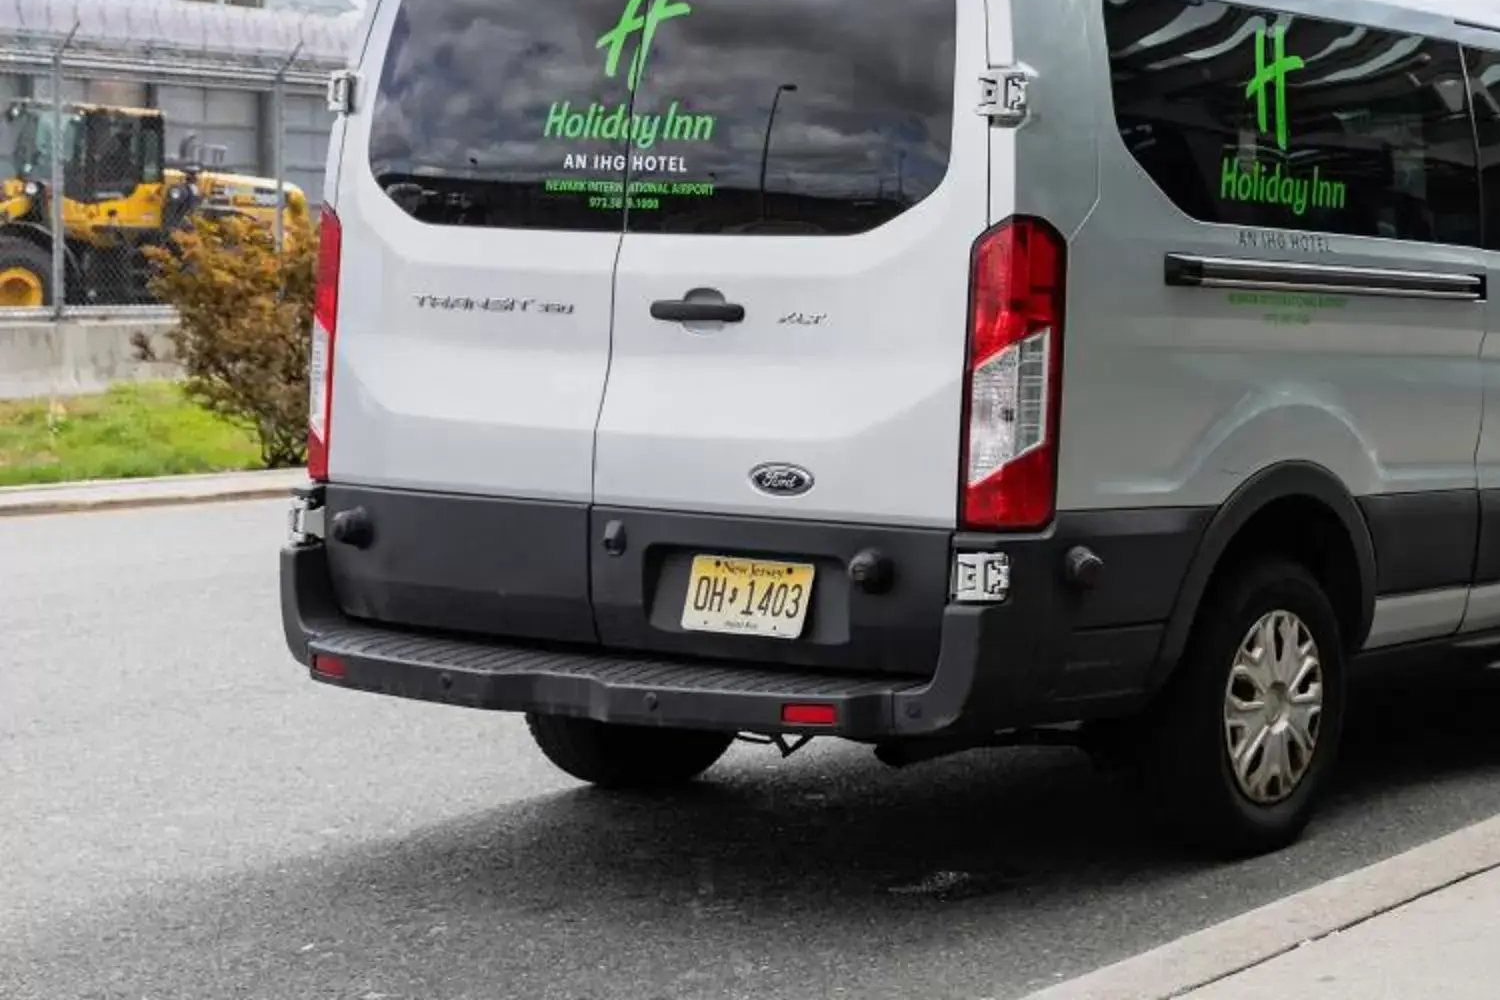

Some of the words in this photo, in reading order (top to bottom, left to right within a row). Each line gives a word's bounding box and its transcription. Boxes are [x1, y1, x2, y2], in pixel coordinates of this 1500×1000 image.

[543, 100, 661, 149] Holiday
[663, 101, 716, 141] Inn
[563, 153, 588, 170] AN
[593, 154, 626, 171] IHG
[632, 155, 688, 173] HOTEL
[1221, 156, 1309, 216] Holiday
[1311, 165, 1346, 209] Inn
[722, 560, 748, 575] New
[748, 563, 785, 581] Jersey
[740, 579, 804, 619] 1403
